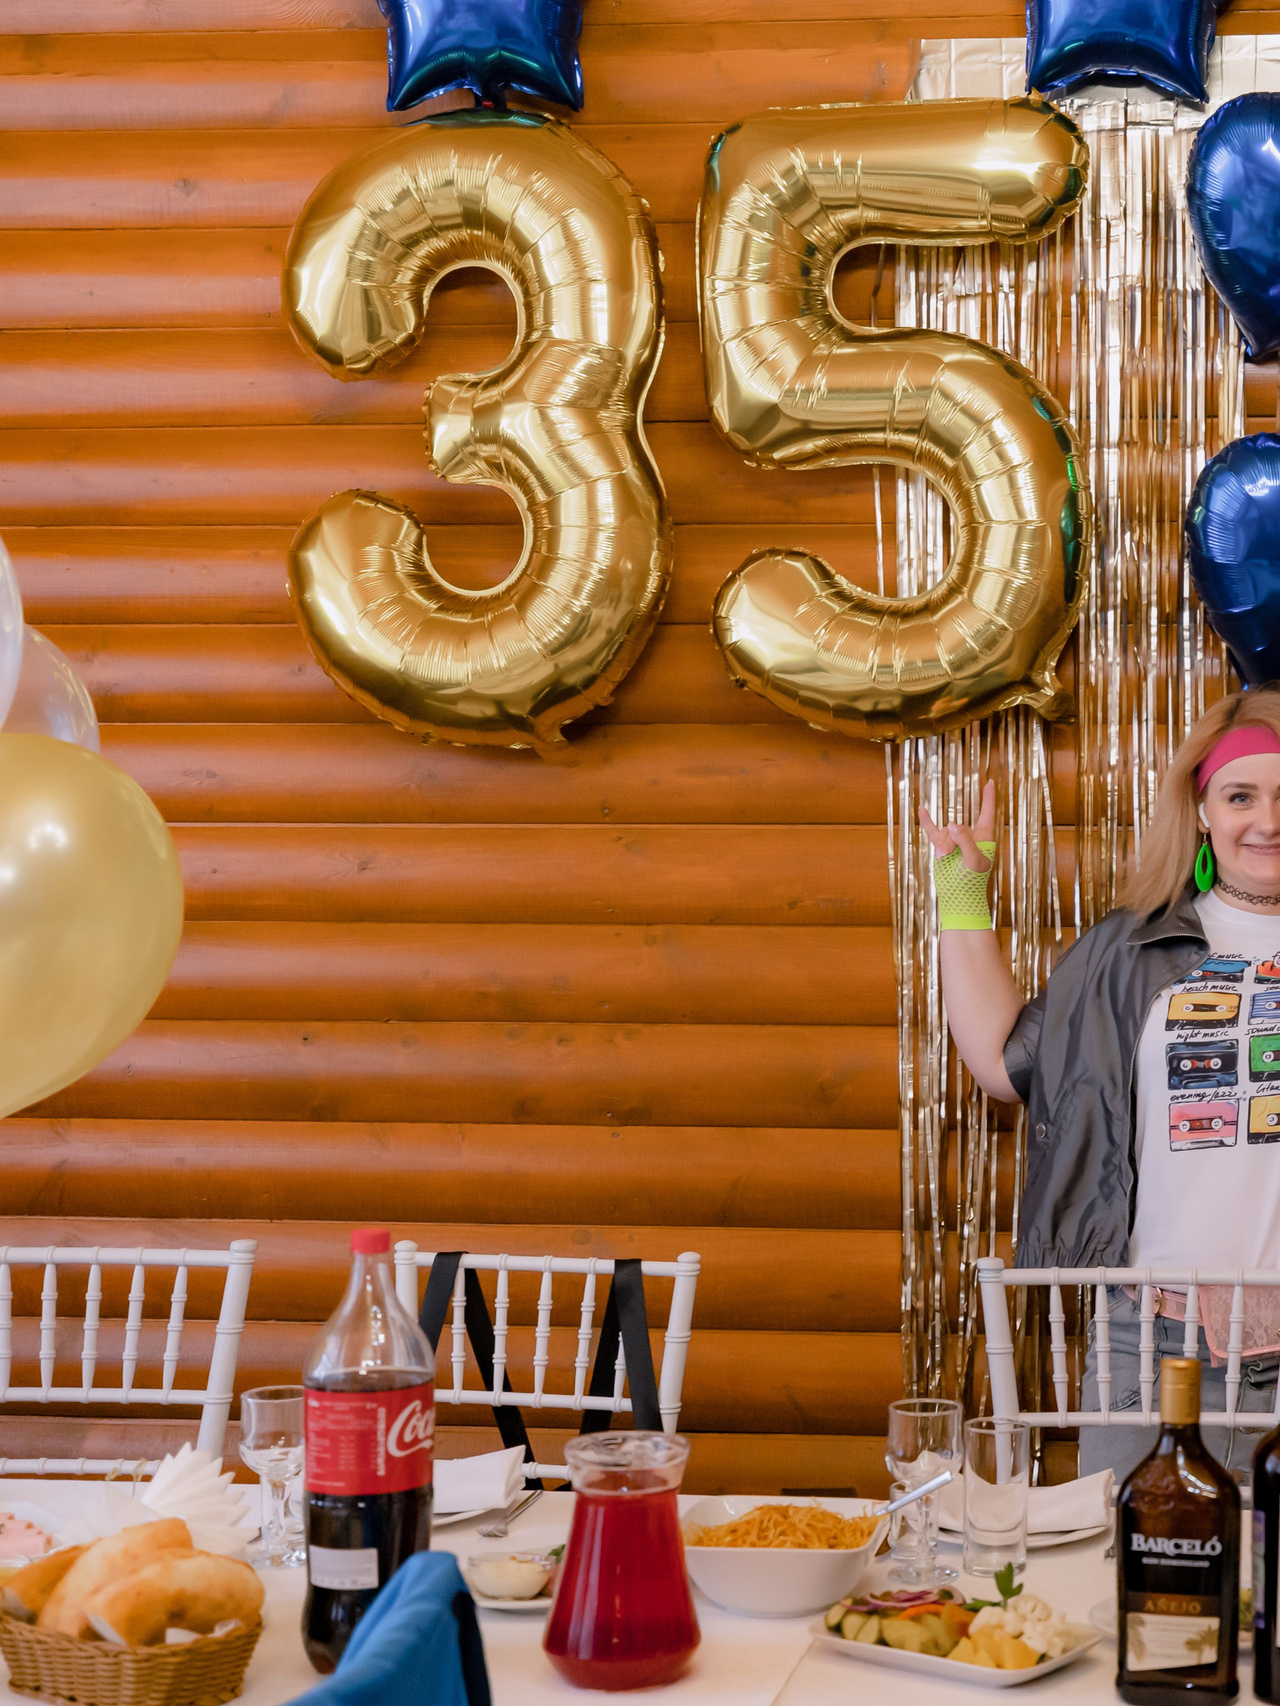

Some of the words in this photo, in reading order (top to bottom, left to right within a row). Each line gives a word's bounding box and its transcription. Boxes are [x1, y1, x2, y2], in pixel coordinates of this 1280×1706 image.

[281, 92, 1092, 750] 35
[1181, 982, 1208, 992] beach
[1176, 1029, 1201, 1042] night
[1202, 1030, 1229, 1038] music
[1244, 1024, 1277, 1035] sound
[1170, 1090, 1212, 1102] evening
[1130, 1532, 1222, 1556] BARCELÓ
